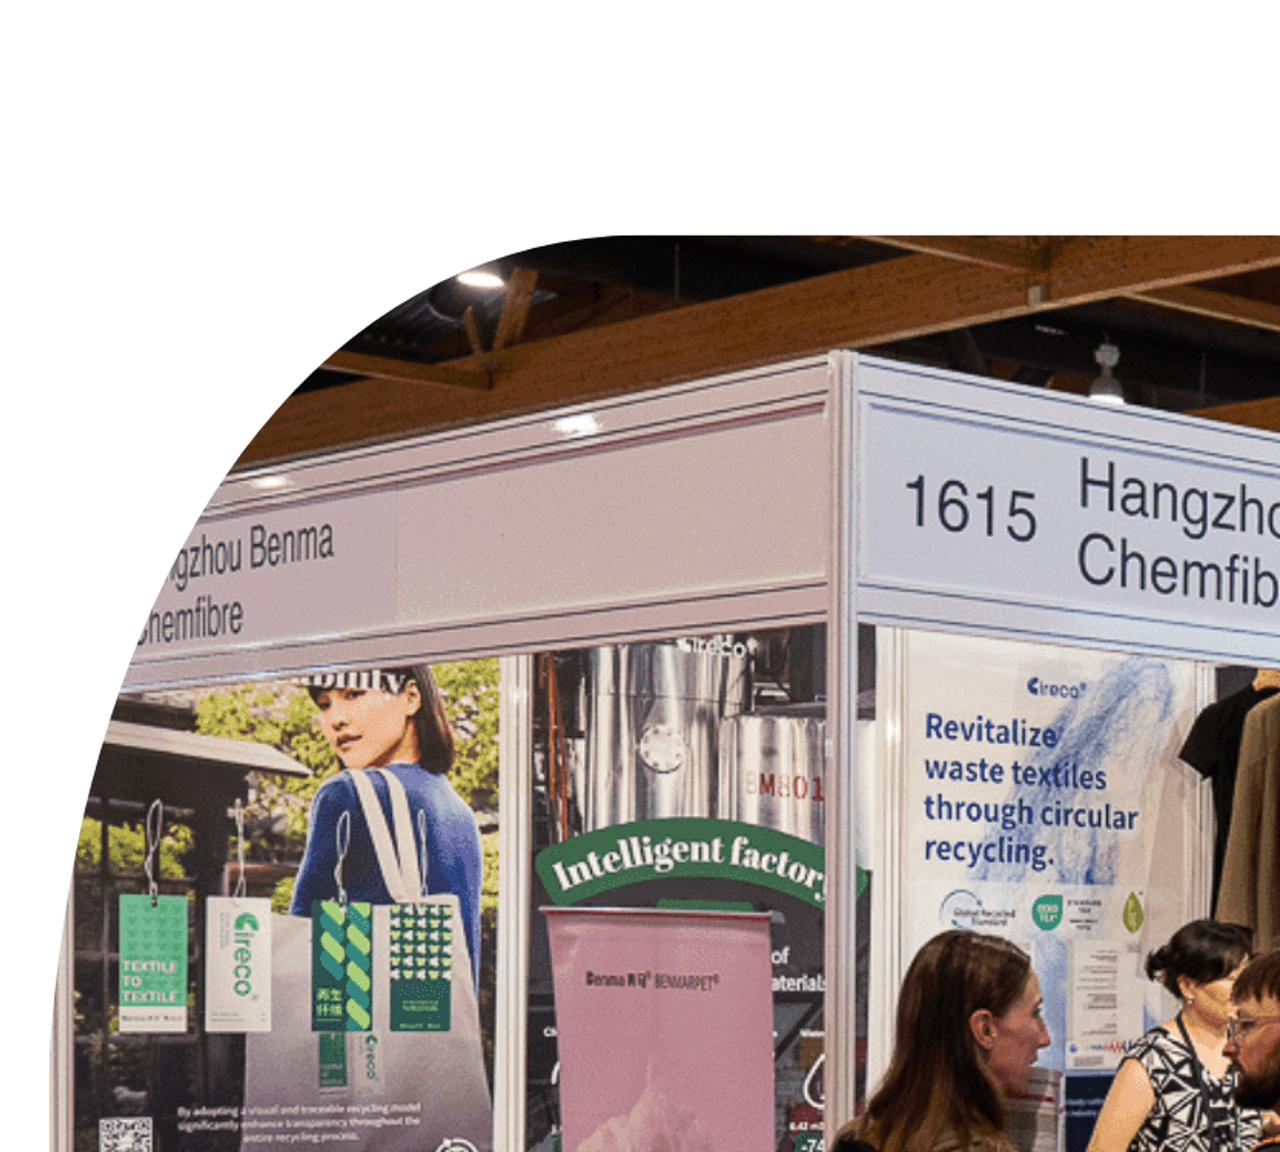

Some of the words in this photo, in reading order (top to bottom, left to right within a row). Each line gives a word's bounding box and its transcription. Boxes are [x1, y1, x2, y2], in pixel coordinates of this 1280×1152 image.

[905, 473, 1037, 542] 1615
[250, 523, 334, 570] Benma
[1027, 677, 1080, 699] Cireco
[925, 713, 1058, 749] Revitalize
[924, 758, 1004, 784] waste
[1012, 760, 1107, 789] textiles
[924, 793, 1034, 830] through
[1040, 800, 1139, 830] circular
[552, 836, 725, 892] Intelligent
[924, 836, 1054, 872] recycling.
[234, 913, 259, 996] Cireco
[771, 947, 790, 964] of
[122, 976, 142, 988] TO
